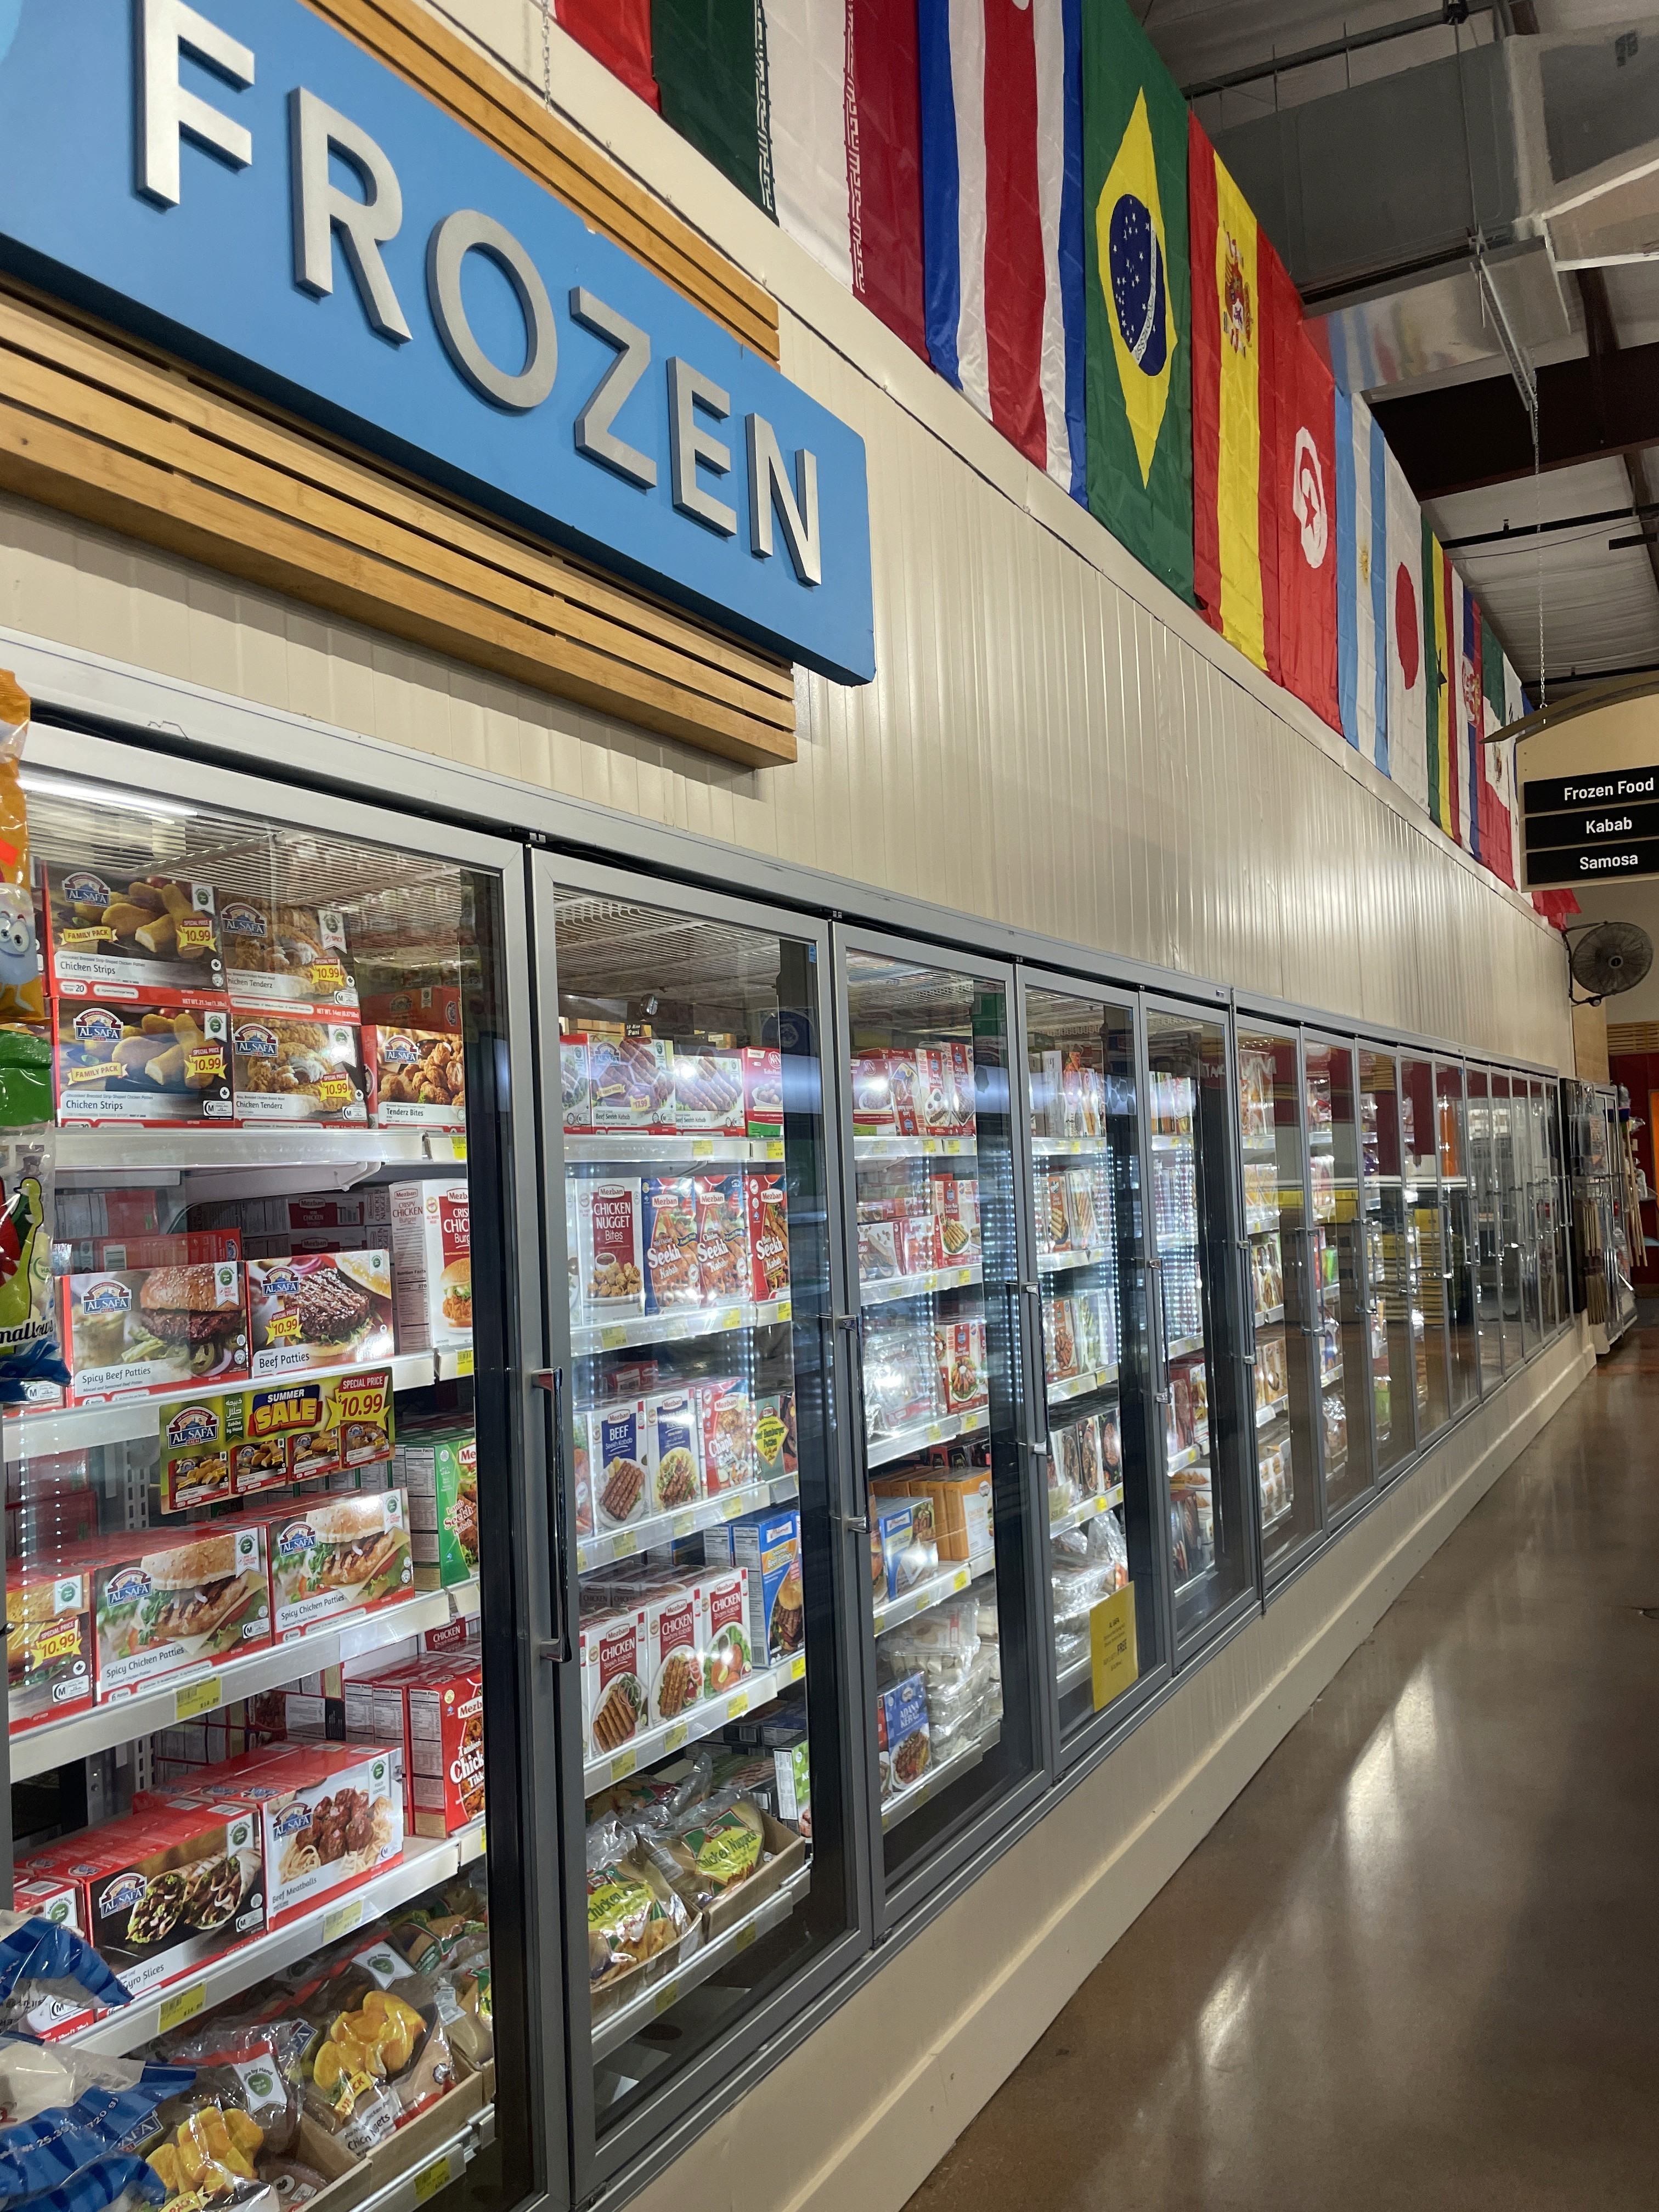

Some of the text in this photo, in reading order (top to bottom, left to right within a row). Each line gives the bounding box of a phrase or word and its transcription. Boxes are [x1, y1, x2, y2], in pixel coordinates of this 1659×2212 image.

[134, 0, 822, 586] FROZEN
[1565, 777, 1654, 800] Frozen Food
[1586, 817, 1632, 834] Kabab
[1580, 855, 1638, 870] Samosa
[69, 890, 106, 903] AL SAFA
[240, 922, 263, 934] SAFA
[60, 962, 115, 975] Chicken Strips
[250, 979, 272, 988] Tenderz
[95, 1029, 119, 1039] SAFA
[239, 1043, 274, 1053] AL SAFA
[66, 1101, 122, 1111] Chicken Strips
[236, 1101, 259, 1109] Chicken
[393, 1206, 422, 1217] CHICKEN
[594, 1203, 630, 1215] CHICKEN
[596, 1216, 630, 1229] NUGGET
[605, 1230, 623, 1240] Bites
[647, 1243, 681, 1268] Seekh
[697, 1239, 729, 1262] Seekh
[756, 1236, 783, 1260] Seekh
[707, 1259, 727, 1272] Kabab
[766, 1256, 781, 1269] Kabab
[659, 1266, 678, 1279] Kabab
[266, 1285, 276, 1294] AL
[87, 1299, 127, 1311] AL SAFA
[259, 1352, 309, 1368] Beef Patties
[82, 1367, 150, 1385] Spicy Beef Patties
[343, 1376, 383, 1389] SPECIAL PRICE
[268, 1389, 304, 1403] SUMMER
[664, 1399, 681, 1407] Mezban
[255, 1398, 316, 1434] SALE
[610, 1413, 629, 1421] Mezban
[172, 1429, 214, 1444] AL SAFA
[610, 1425, 629, 1441] BEEF
[606, 1442, 618, 1450] Seekh
[447, 1499, 463, 1515] Lamb
[444, 1507, 473, 1530] Seekh
[283, 1538, 313, 1553] AL SAFA
[111, 1584, 148, 1602] AL SAFA
[281, 1595, 344, 1620] Spicy Chicken Patties
[668, 1603, 686, 1613] Mezban
[713, 1592, 741, 1612] CHICKEN
[41, 1621, 74, 1639] SPECIAL PRICE
[246, 1626, 252, 1635] M
[662, 1612, 692, 1635] CHICKEN
[433, 1626, 461, 1643] CHICKEN
[608, 1627, 628, 1638] Mezban
[601, 1638, 635, 1661] CHICKEN
[107, 1647, 184, 1678] Spicy Chicken Patties
[604, 1652, 633, 1669] Seekh Kabab
[460, 1701, 482, 1716] Mezb
[275, 1817, 309, 1836] AL SAFA
[696, 1830, 757, 1868] Chicken Nuggets
[273, 1877, 317, 1903] Beef Meatballs
[105, 1890, 142, 1913] AL SAFA
[123, 1964, 164, 1990] Gyro Slices
[57, 2004, 64, 2012] M
